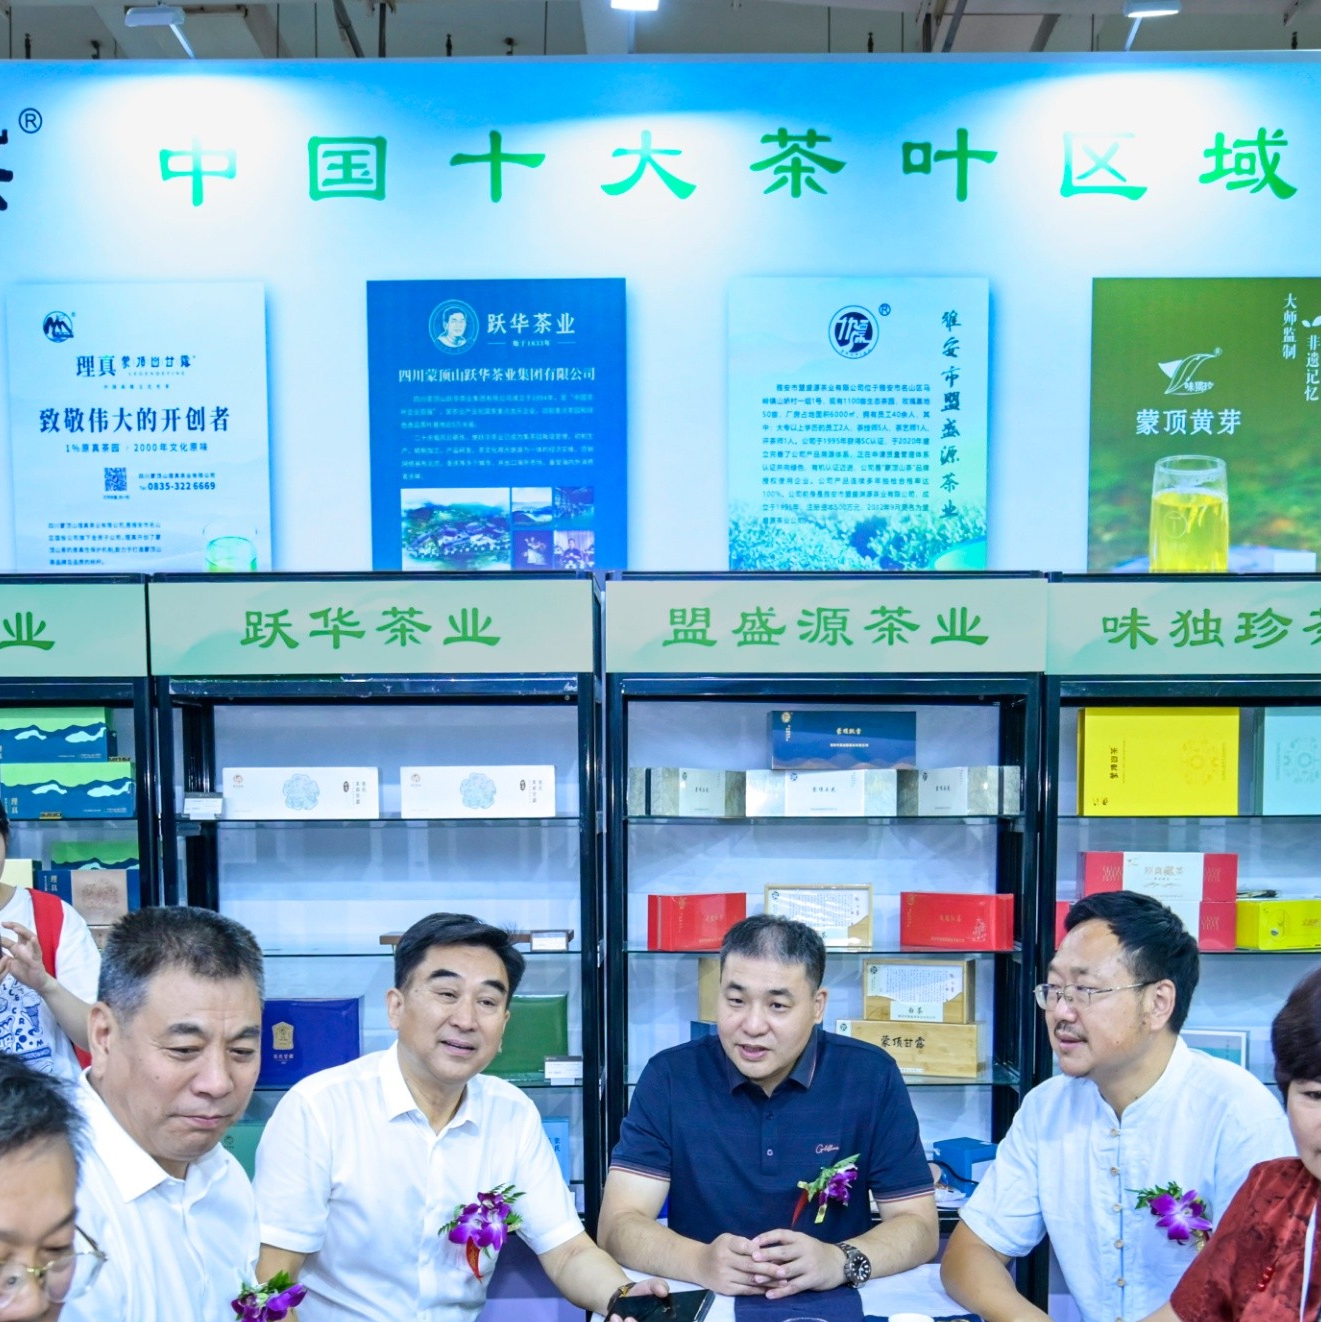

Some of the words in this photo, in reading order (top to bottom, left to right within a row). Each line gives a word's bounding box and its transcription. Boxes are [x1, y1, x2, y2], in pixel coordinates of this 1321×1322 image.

[487, 313, 575, 334] 跃华茶业
[1282, 292, 1298, 360] 大师监制
[399, 367, 595, 383] 四川蒙顶山跃华茶业集团有限公司
[1304, 334, 1321, 402] 非遗记忆
[39, 406, 229, 433] 致敬伟大的开创者
[939, 309, 962, 519] 雅安市盟盛源茶业
[1135, 409, 1242, 435] 蒙顶黄芽
[193, 482, 215, 490] 6669
[241, 605, 501, 649] 跃华茶业
[662, 605, 989, 648] 盟盛源茶业
